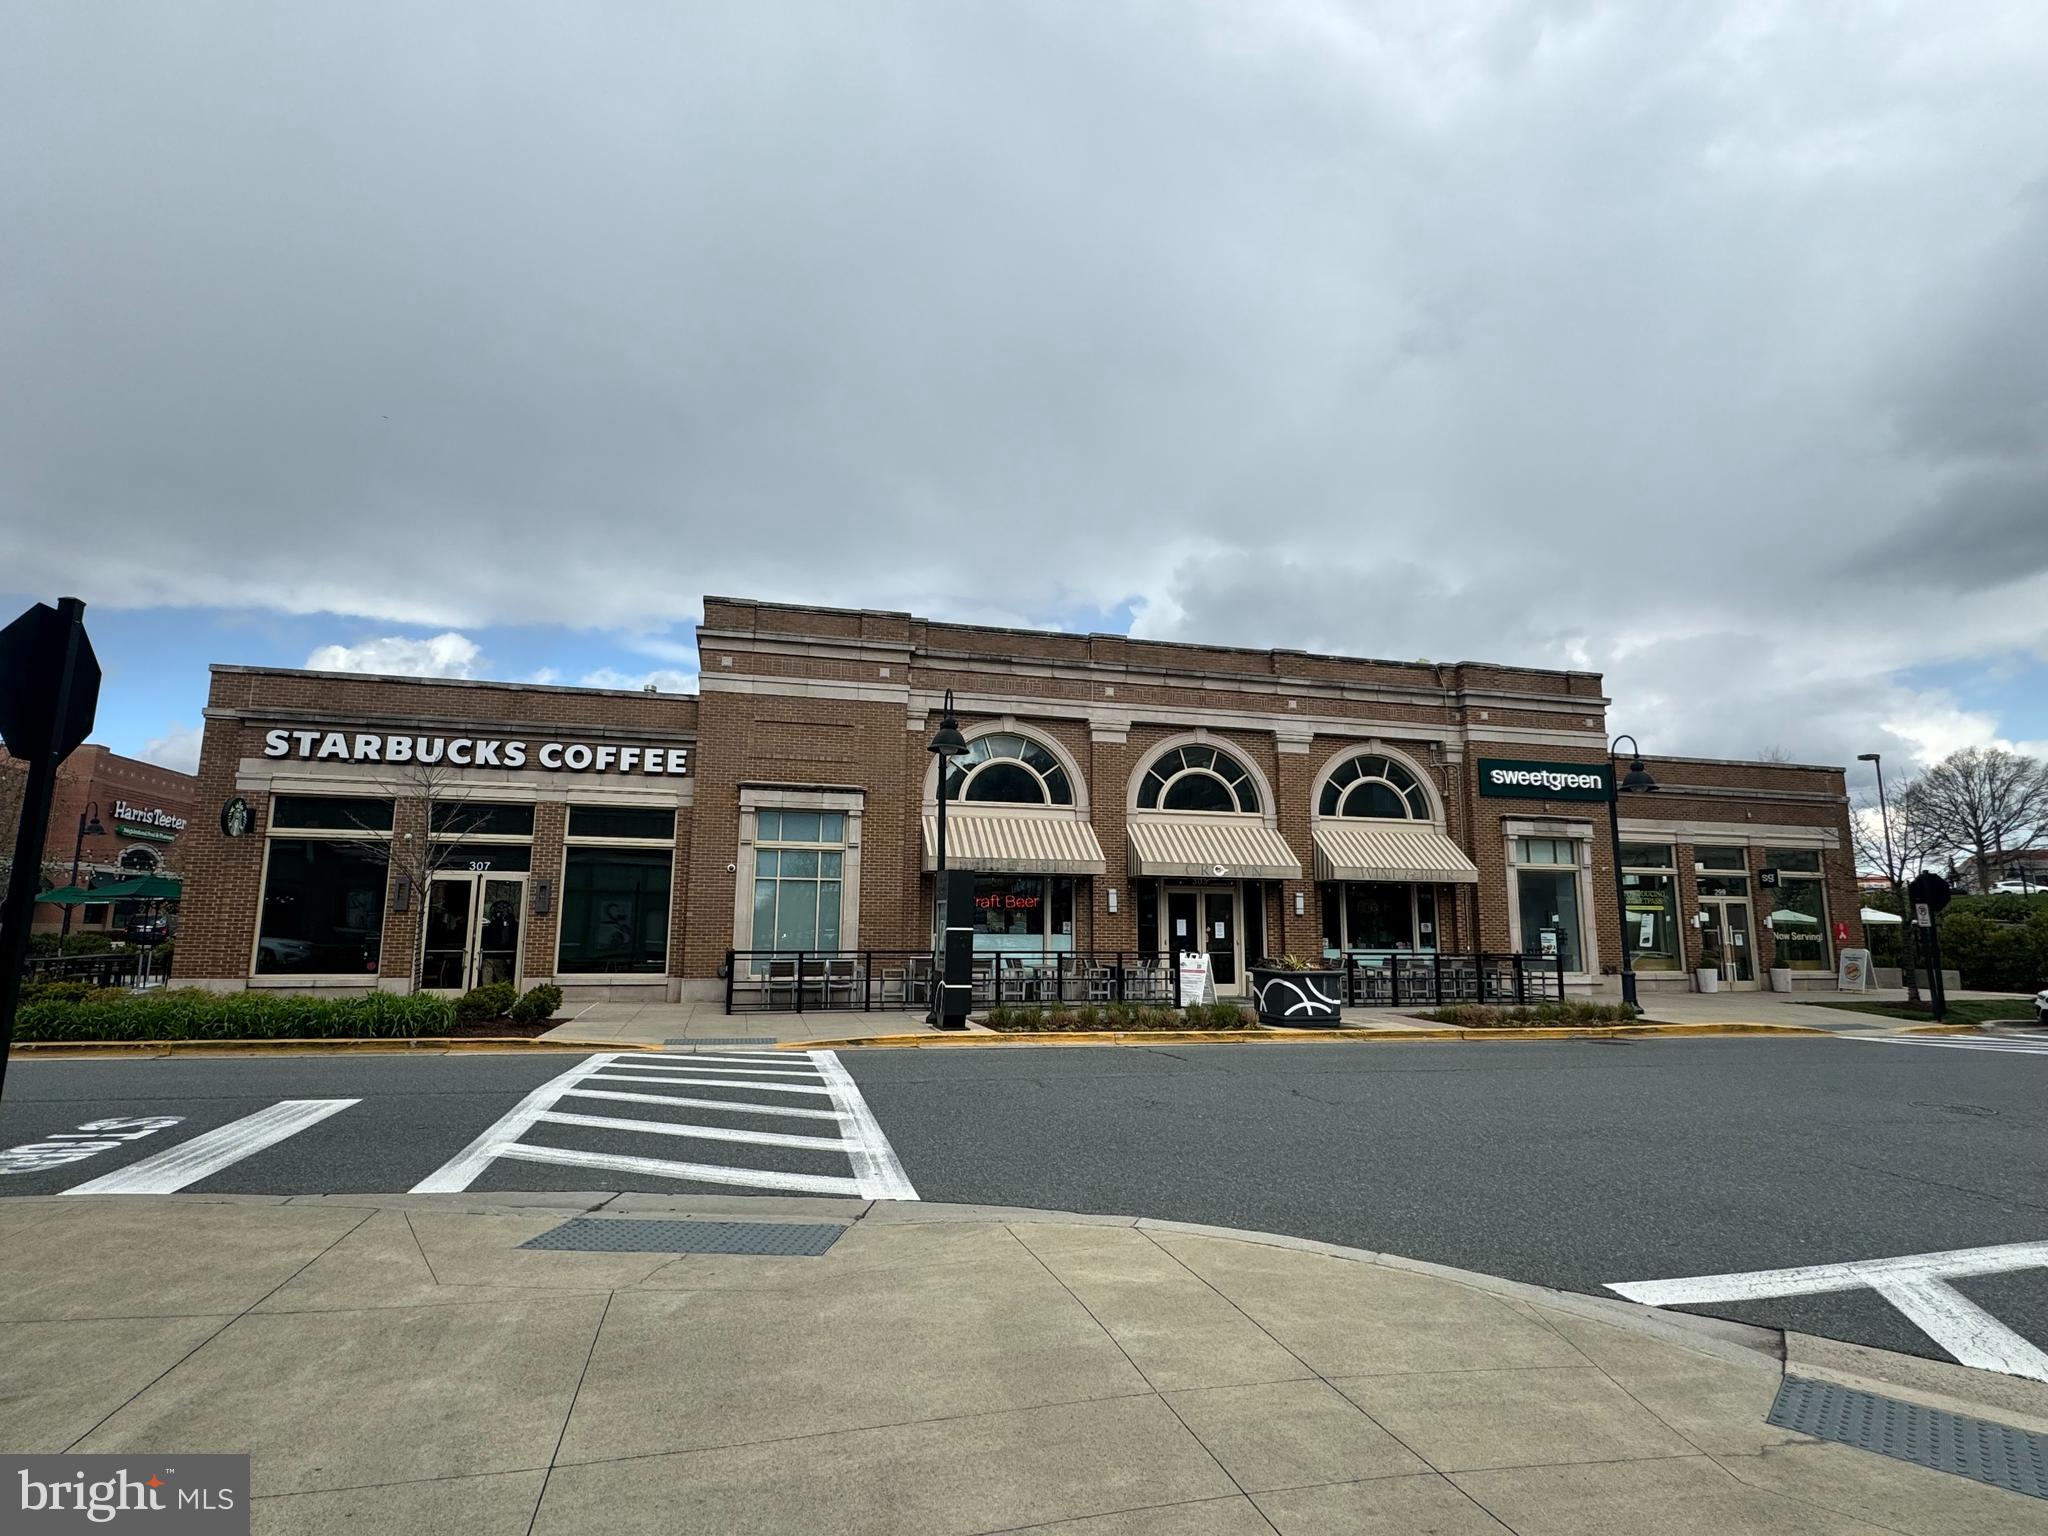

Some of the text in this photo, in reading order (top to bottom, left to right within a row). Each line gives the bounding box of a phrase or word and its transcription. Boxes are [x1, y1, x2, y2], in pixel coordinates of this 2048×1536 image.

[263, 730, 688, 773] STARBUCKS COFFEE
[1490, 769, 1602, 791] sweetgreen
[114, 800, 187, 830] Harris Teeter
[469, 861, 492, 871] 307
[1761, 873, 1775, 883] sg
[974, 895, 1040, 908] raft Beer
[1773, 931, 1823, 942] Now Serving!
